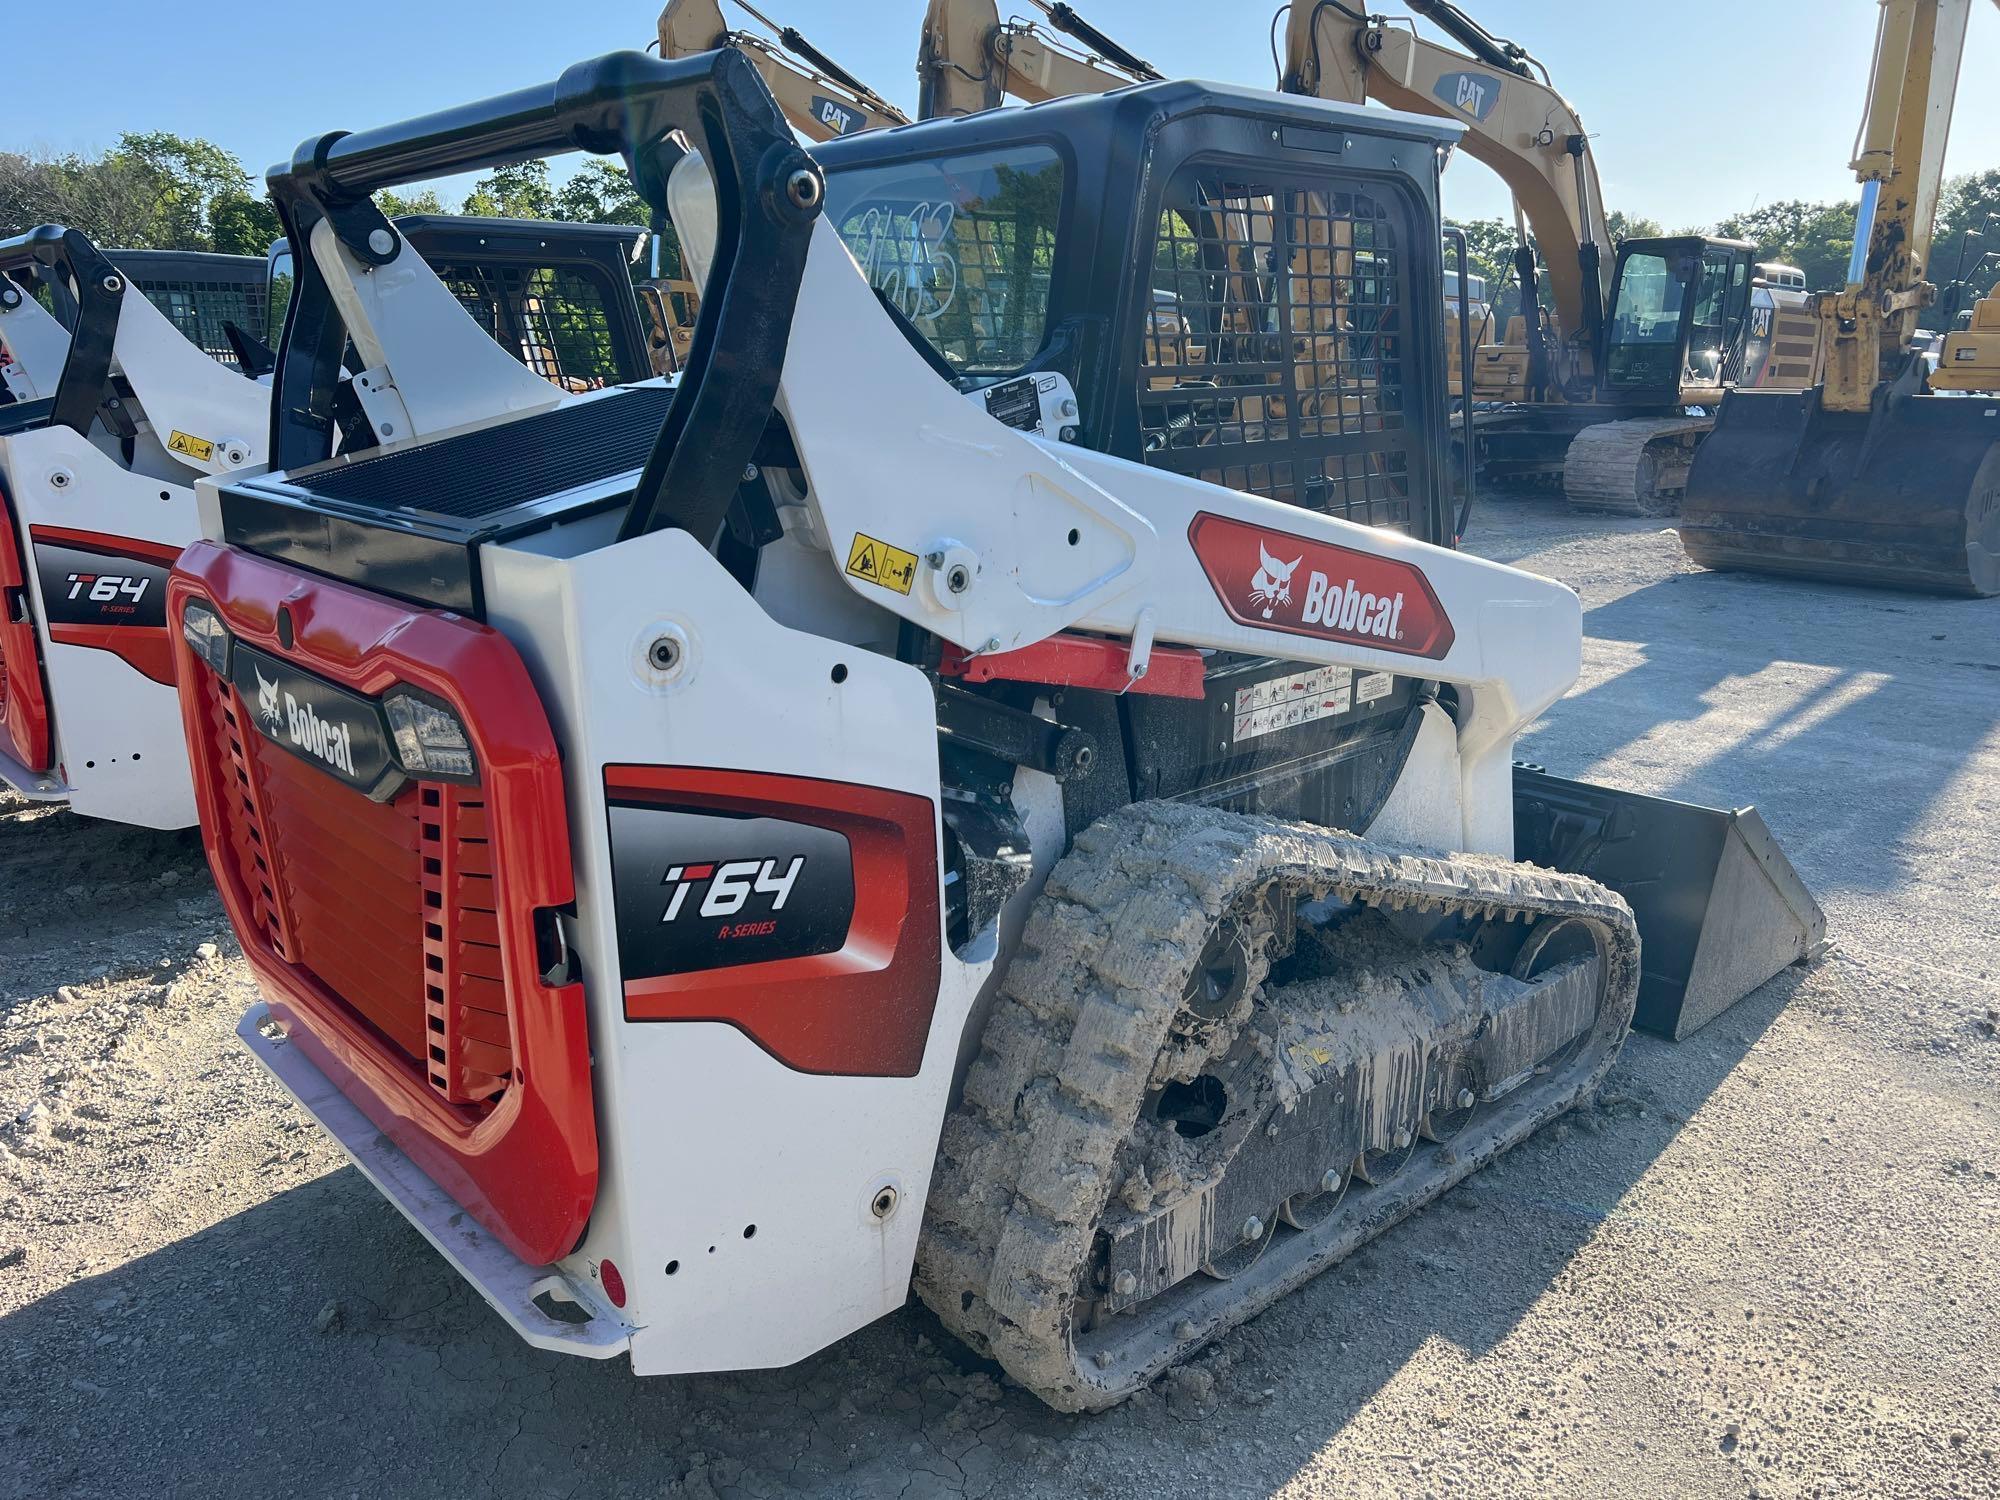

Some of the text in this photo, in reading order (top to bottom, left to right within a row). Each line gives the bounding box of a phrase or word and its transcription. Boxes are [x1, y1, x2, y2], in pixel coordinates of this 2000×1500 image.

[1456, 74, 1485, 117] CAT
[821, 101, 851, 134] CAT
[1751, 307, 1771, 336] CAT
[67, 574, 150, 603] T64
[1301, 570, 1404, 640] Bobcat
[101, 605, 136, 614] R-SERIES
[284, 691, 355, 777] Bobcat
[662, 857, 805, 922] T64
[718, 920, 777, 939] R-SERIES
